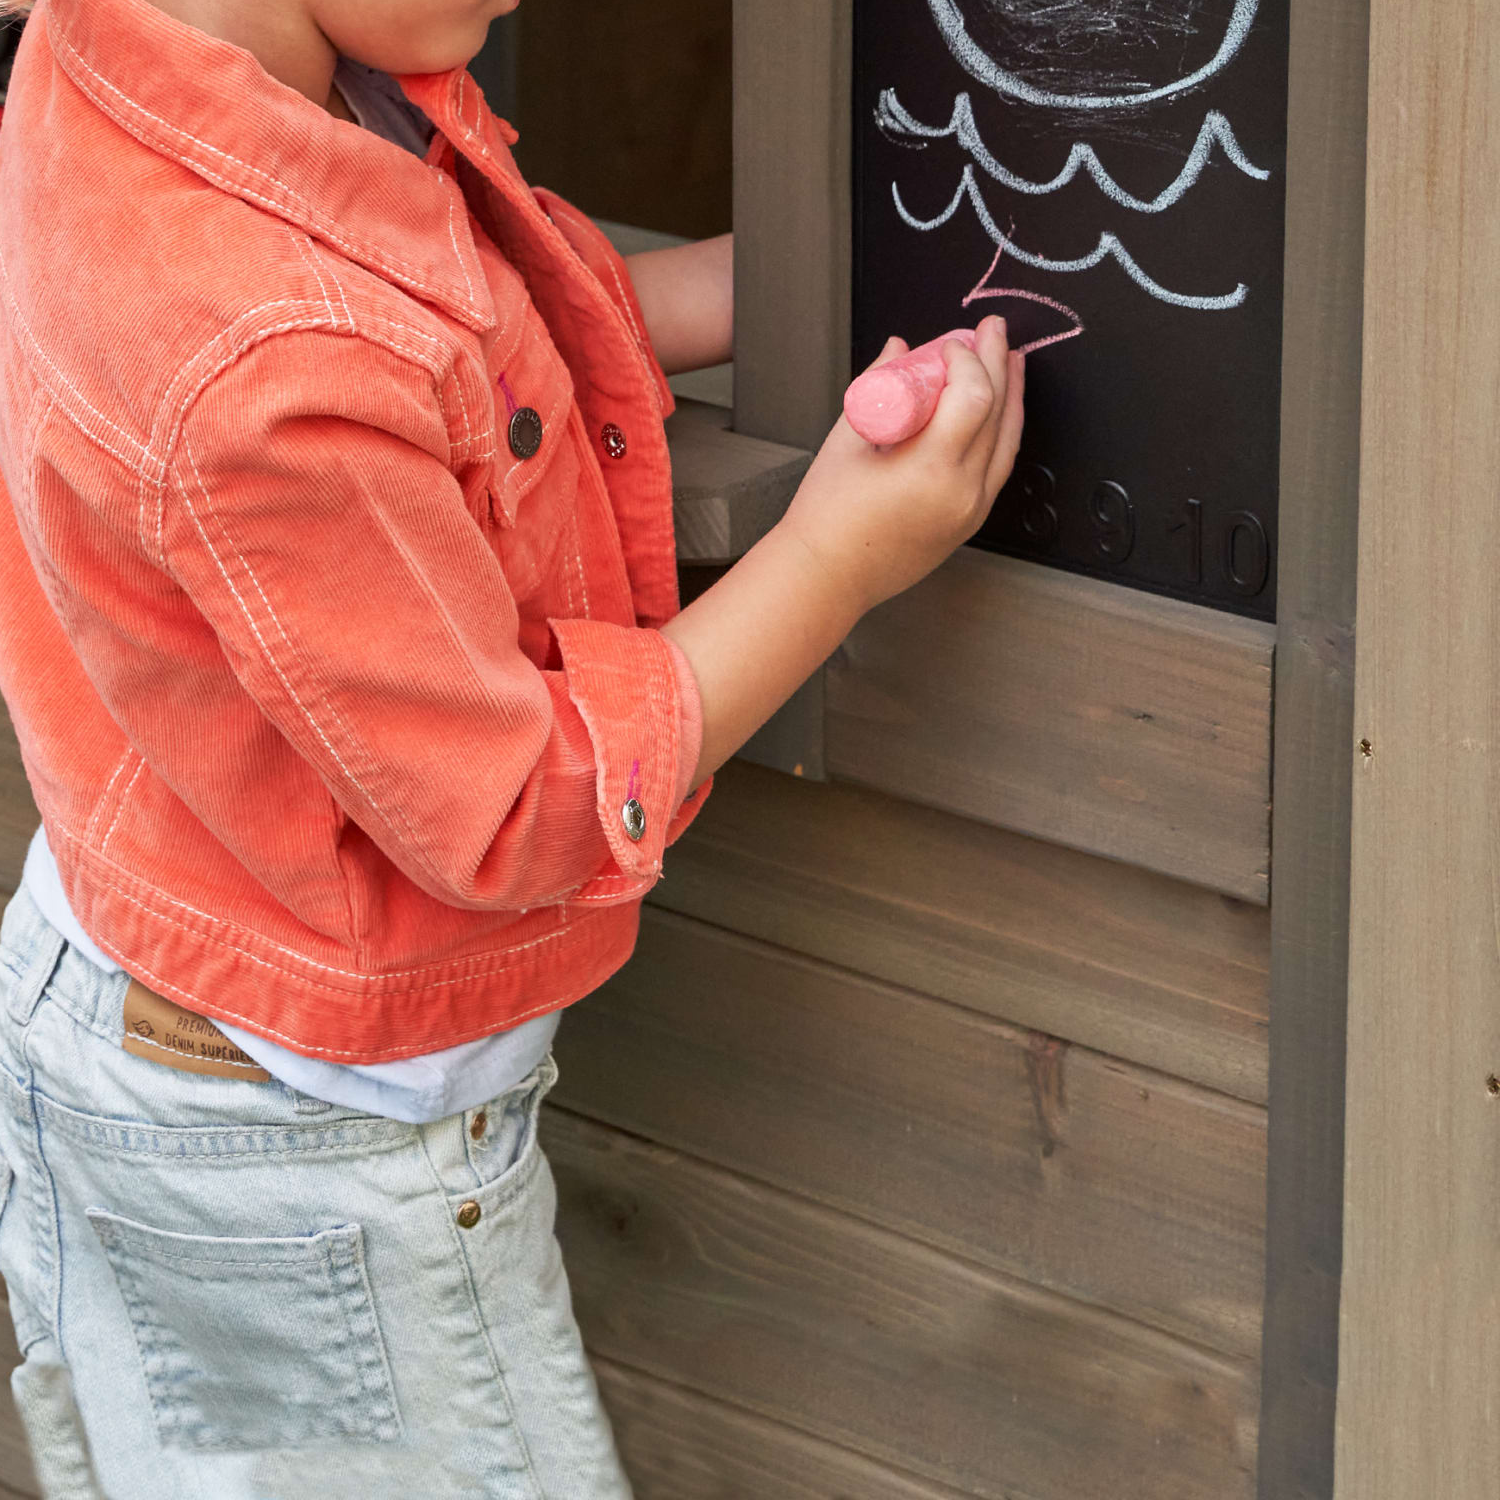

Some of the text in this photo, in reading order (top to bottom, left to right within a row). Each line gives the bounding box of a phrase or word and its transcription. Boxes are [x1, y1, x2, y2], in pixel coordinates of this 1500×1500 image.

[1015, 462, 1270, 598] 8 9 10
[165, 1032, 195, 1052] DENIM
